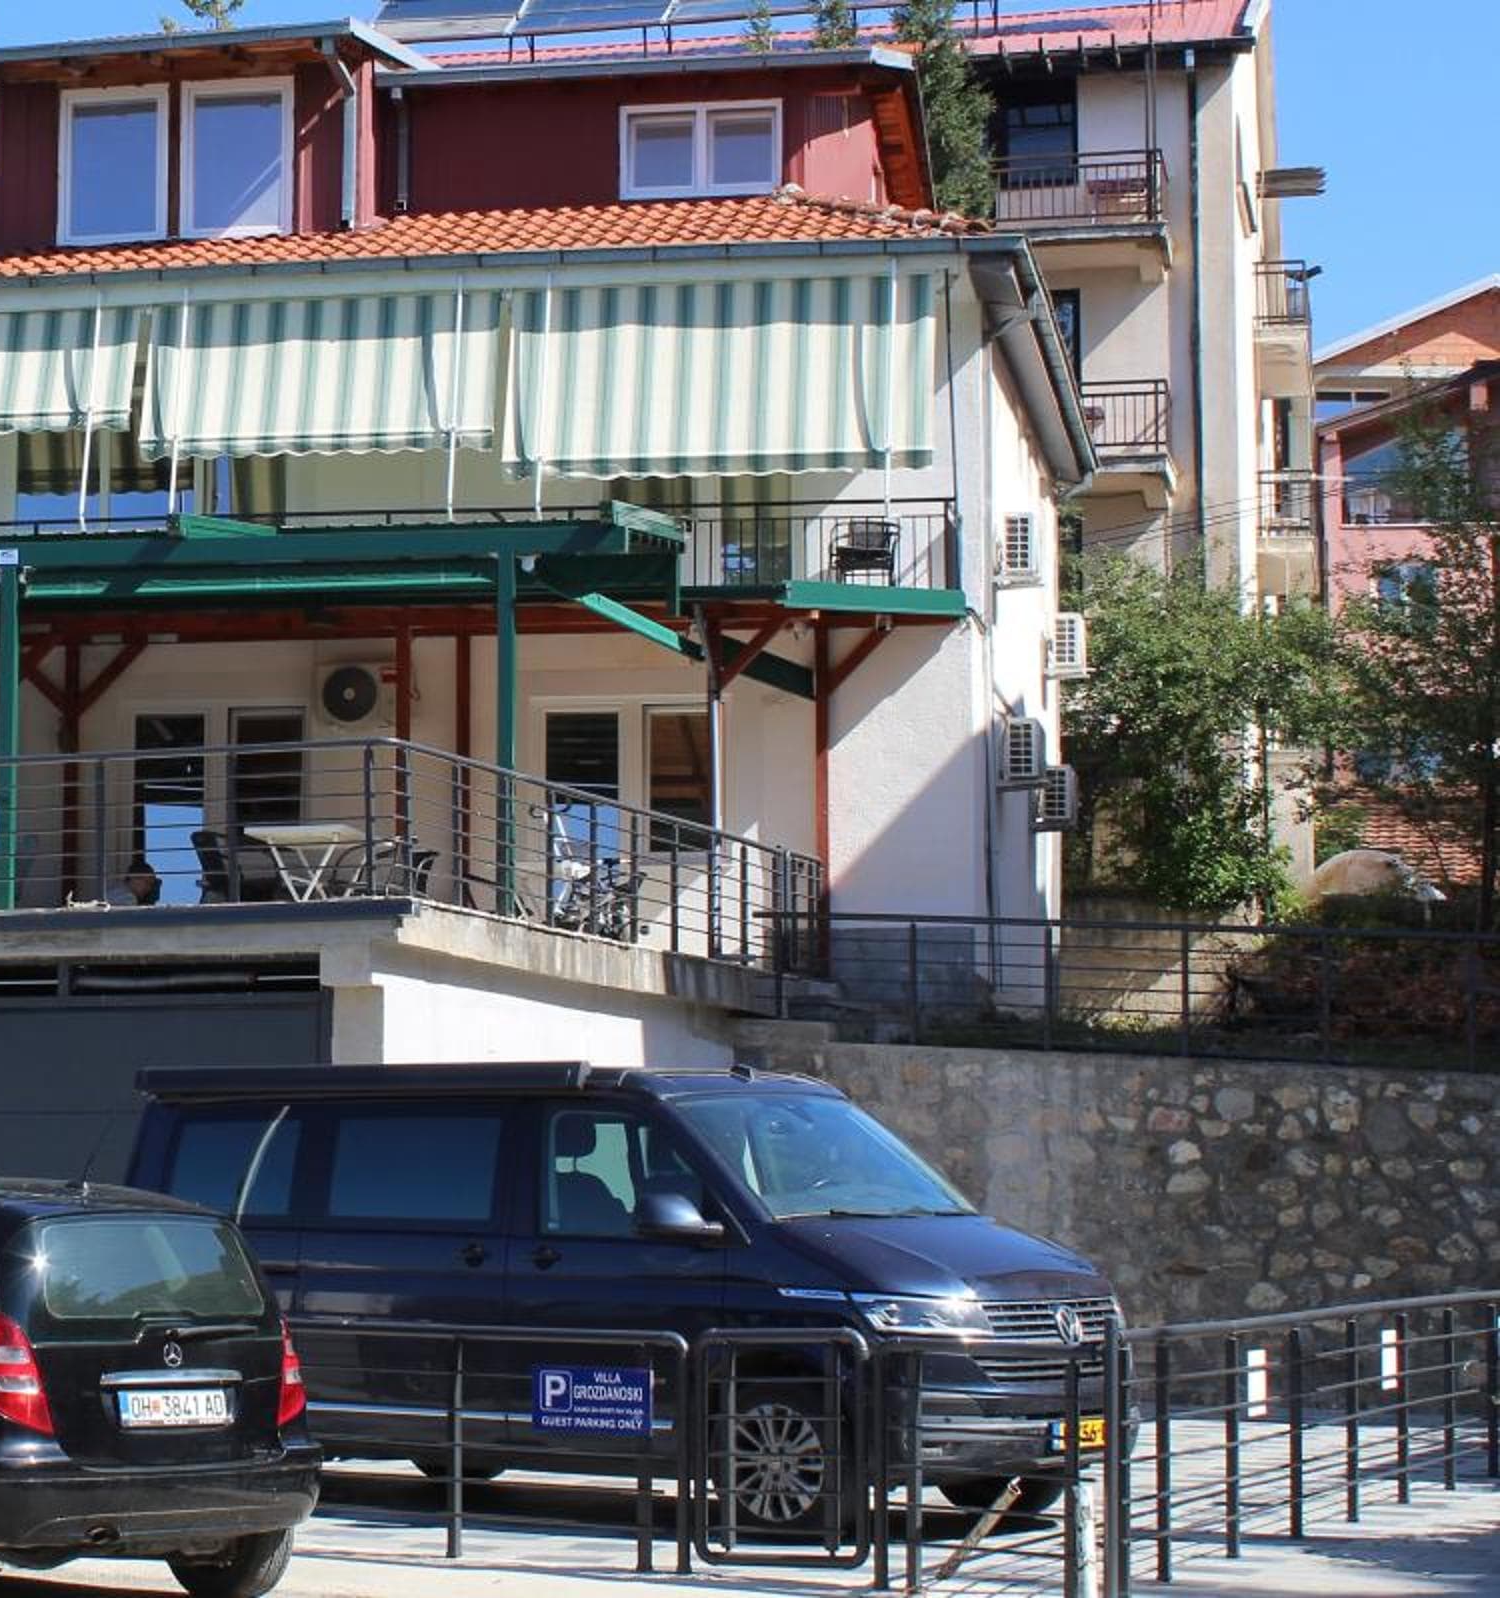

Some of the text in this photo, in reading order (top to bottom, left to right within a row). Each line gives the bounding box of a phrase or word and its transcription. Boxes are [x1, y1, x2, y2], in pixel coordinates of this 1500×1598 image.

[593, 1372, 622, 1384] VILLA
[545, 1375, 566, 1407] P
[573, 1385, 643, 1402] GROZDANOSKI
[131, 1394, 224, 1418] OH 3841 AD
[541, 1416, 643, 1430] GUEST PARKING ONLY
